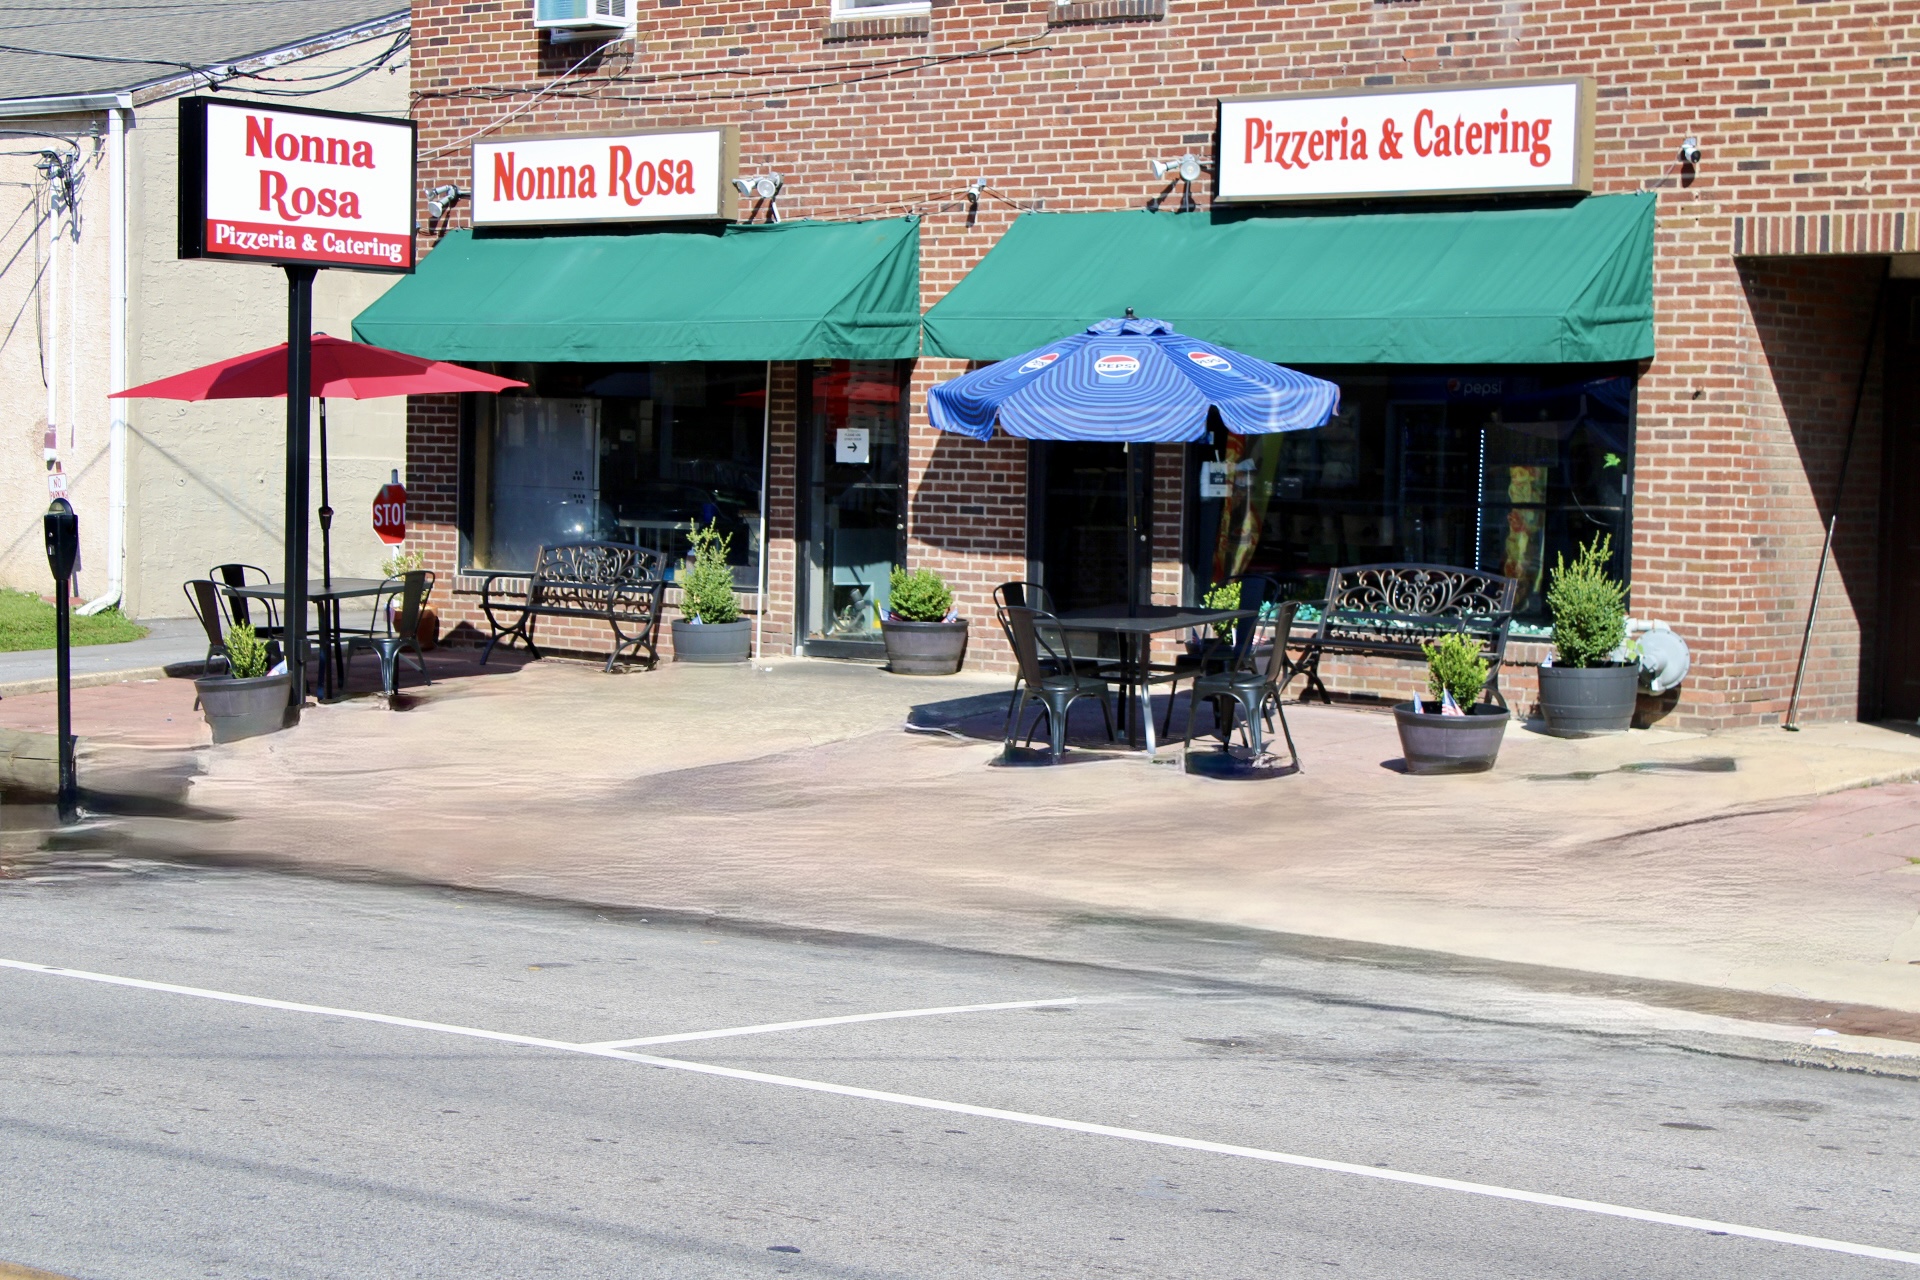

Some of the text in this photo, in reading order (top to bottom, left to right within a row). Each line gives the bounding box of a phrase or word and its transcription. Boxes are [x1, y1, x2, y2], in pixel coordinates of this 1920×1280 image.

[245, 115, 376, 170] Nonna
[1244, 108, 1553, 170] Pizzeria & Catering
[259, 169, 362, 222] Rosa
[493, 145, 696, 207] Nonna Rosa
[215, 223, 403, 264] Pizzeria & Catering
[1463, 380, 1503, 397] pepsi
[53, 476, 62, 489] NO
